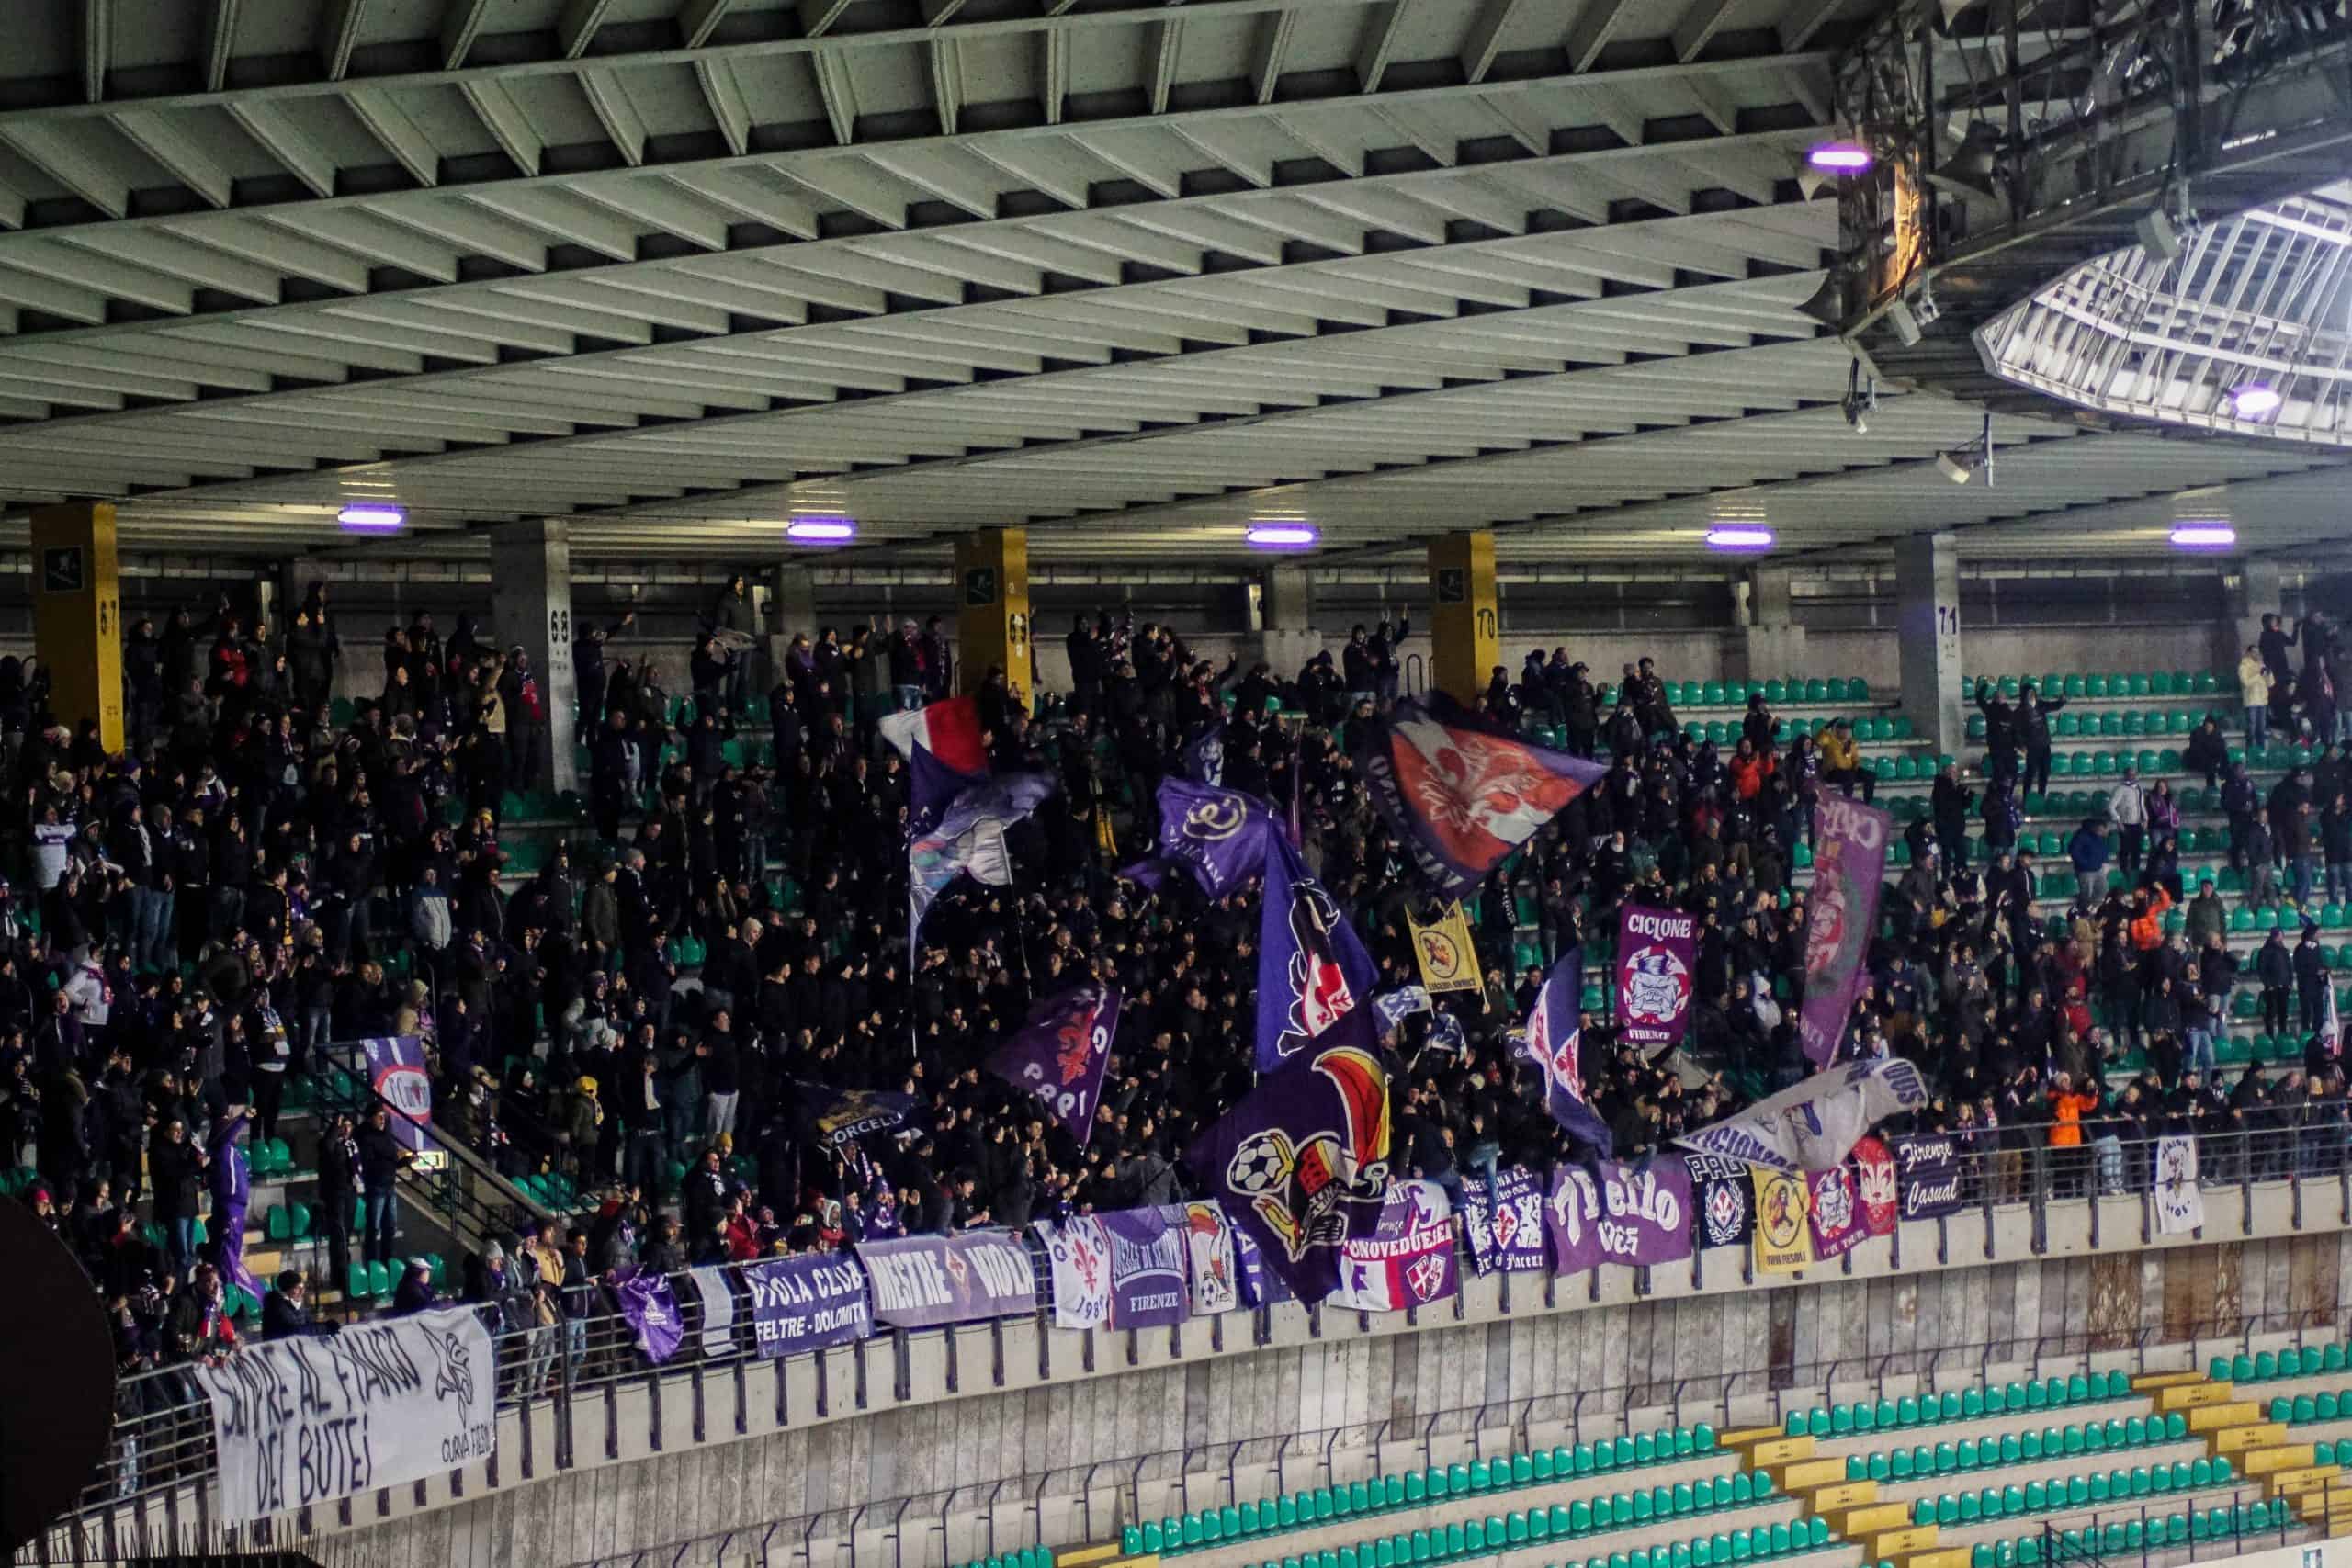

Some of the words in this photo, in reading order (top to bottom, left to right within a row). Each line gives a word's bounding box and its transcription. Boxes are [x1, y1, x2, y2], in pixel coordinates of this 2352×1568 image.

[551, 610, 568, 642] 68
[1010, 613, 1026, 642] 69
[1477, 608, 1495, 640] 70
[1939, 606, 1956, 635] 71
[1627, 913, 1692, 942] CICLONE
[1899, 1142, 1953, 1174] Firenze
[1907, 1175, 1959, 1216] Casual
[748, 1273, 813, 1309] VIOLA
[812, 1258, 865, 1300] CLUB
[866, 1249, 954, 1311] MESTRE
[964, 1243, 1035, 1299] VIOLA
[1130, 1292, 1179, 1313] FIRENZE
[755, 1315, 806, 1343] FELTRE
[209, 1345, 294, 1437] SEMPRE
[286, 1338, 331, 1416] AL
[256, 1425, 284, 1514] DEI
